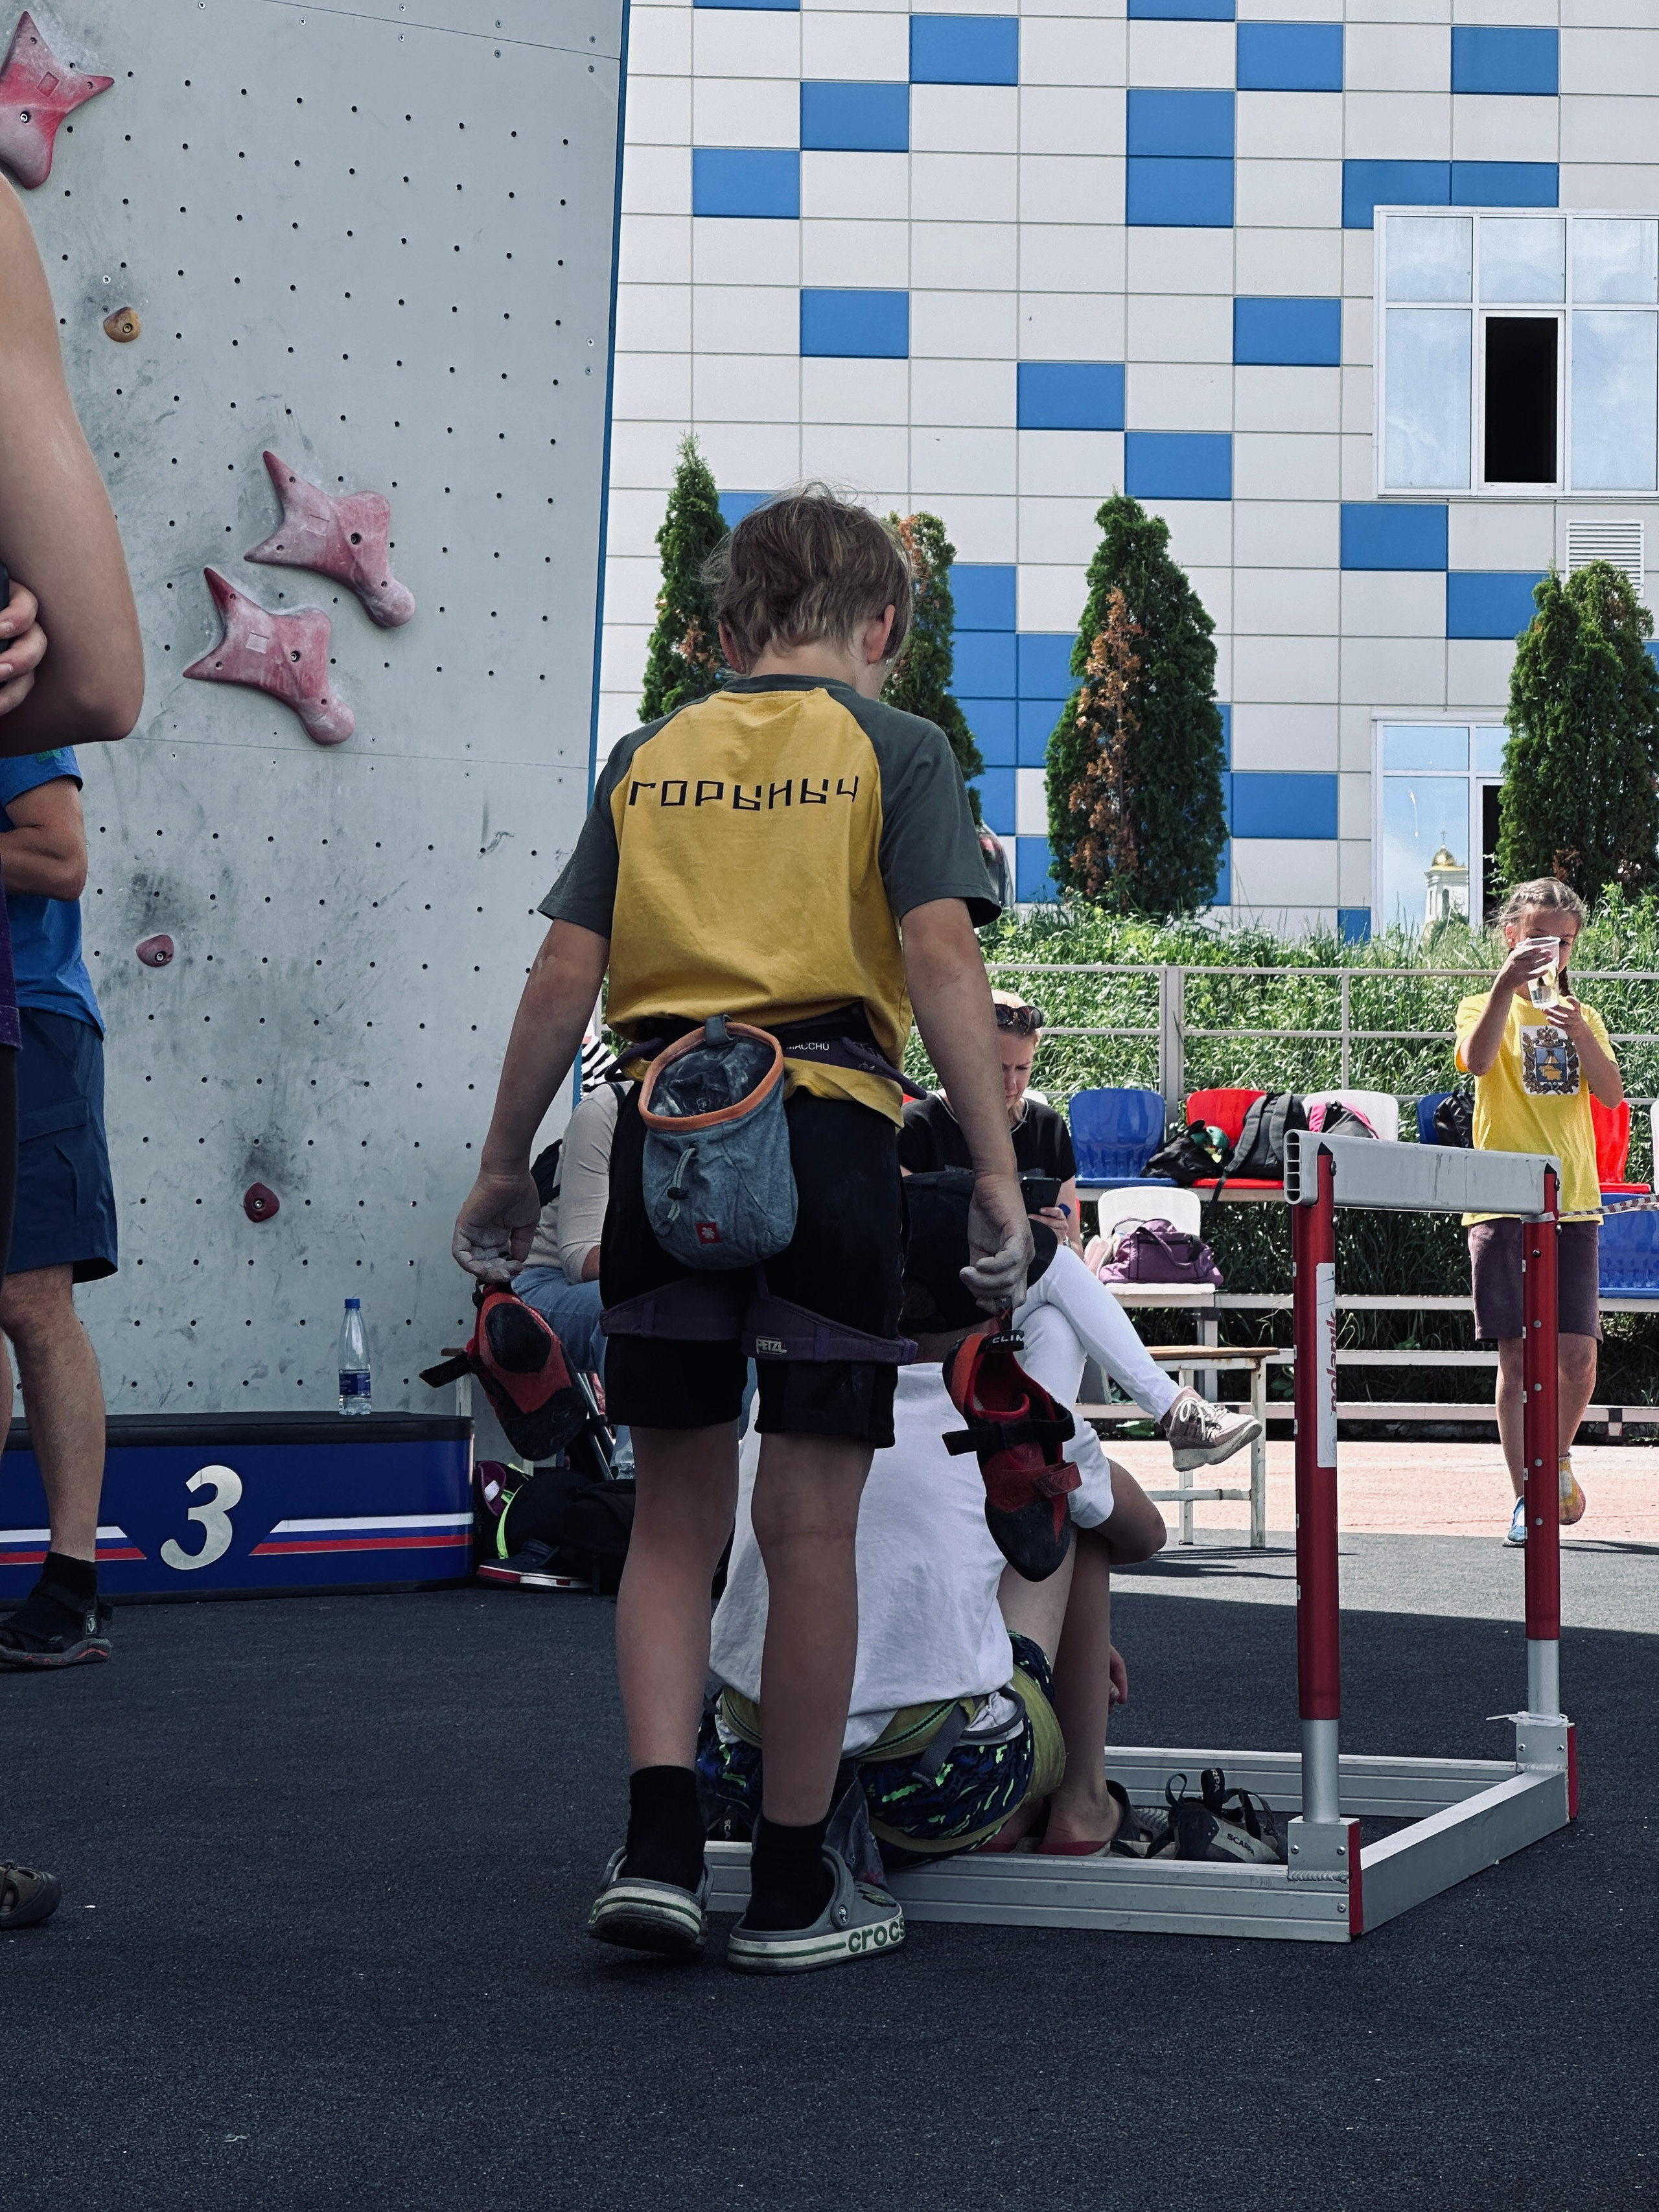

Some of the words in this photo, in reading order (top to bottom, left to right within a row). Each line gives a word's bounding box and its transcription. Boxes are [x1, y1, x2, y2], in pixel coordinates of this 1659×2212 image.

[628, 775, 859, 811] ГОРЫНЫЧ
[756, 1337, 788, 1355] PETZL
[160, 1465, 242, 1570] 3
[1226, 1833, 1255, 1857] SCARPA
[848, 1917, 905, 1953] crocs
